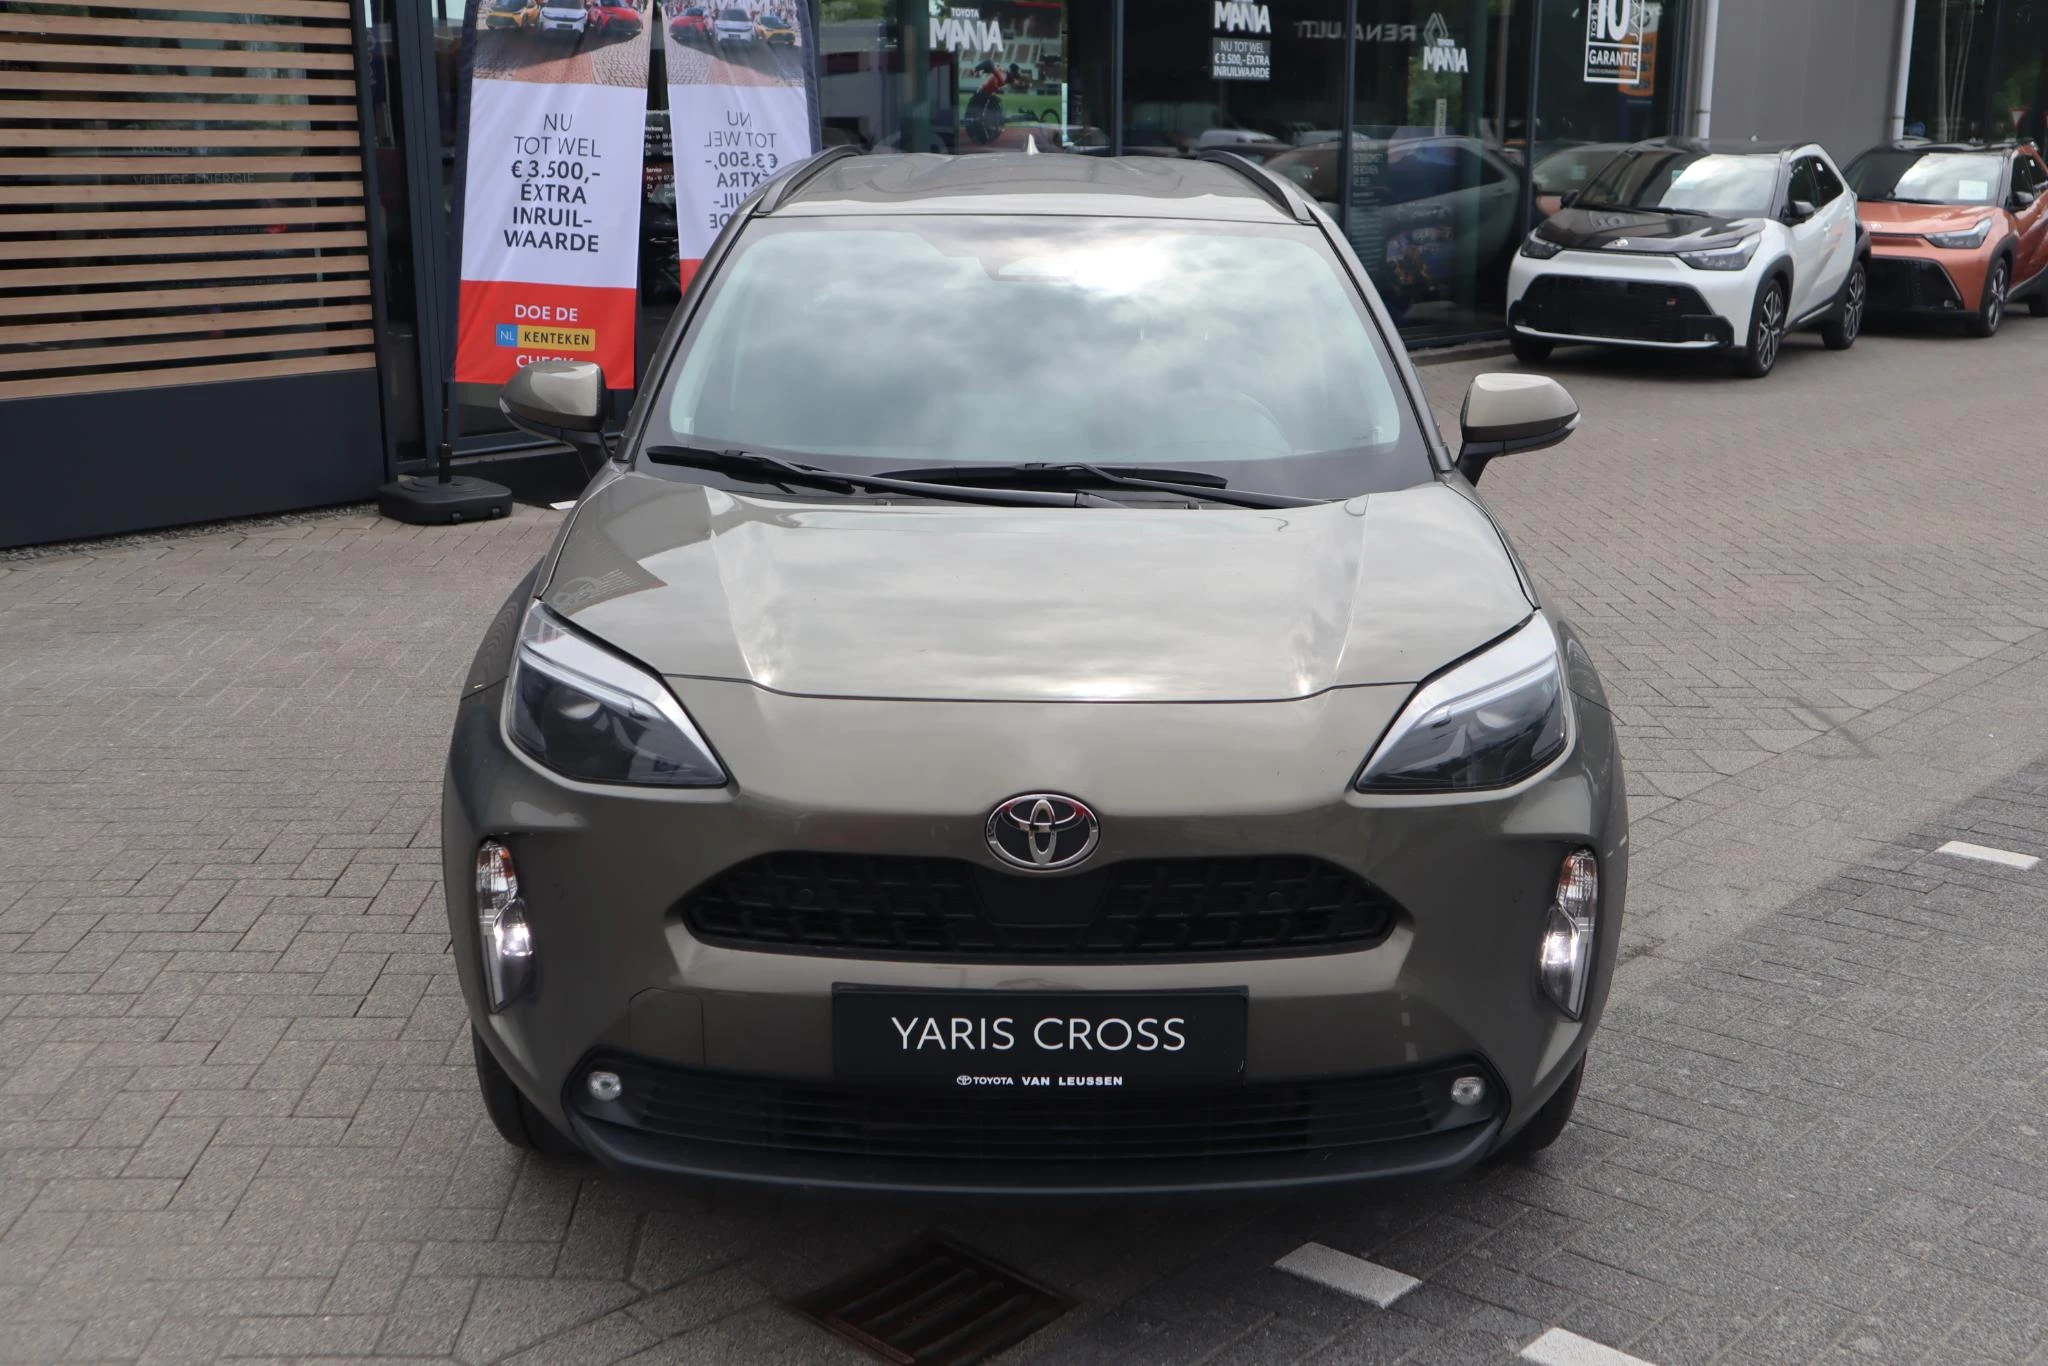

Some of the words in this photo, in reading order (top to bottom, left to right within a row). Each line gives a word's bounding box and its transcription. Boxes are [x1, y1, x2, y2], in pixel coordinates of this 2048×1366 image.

[951, 8, 979, 17] TOYOTA
[1214, 1, 1271, 33] MANIA
[929, 17, 1004, 53] MANIA
[1423, 46, 1469, 73] MANIA
[1589, 49, 1638, 67] GARANTIE
[1213, 65, 1270, 79] INRUILWAARDE
[543, 113, 573, 132] NU
[513, 136, 552, 155] TOT
[558, 137, 601, 158] WEL
[520, 178, 587, 204] ÉXTRA
[513, 206, 593, 228] INRUIL-
[503, 229, 599, 253] WAARDE
[515, 304, 551, 320] DOE
[556, 307, 578, 322] DE
[500, 330, 514, 341] NL
[524, 331, 590, 345] KENTEKEN
[891, 1016, 1015, 1050] YARIS
[1033, 1017, 1186, 1051] CROSS
[973, 1076, 1014, 1086] TOYOTA
[1022, 1076, 1050, 1086] VAN
[1058, 1076, 1123, 1086] LEUSSEN
